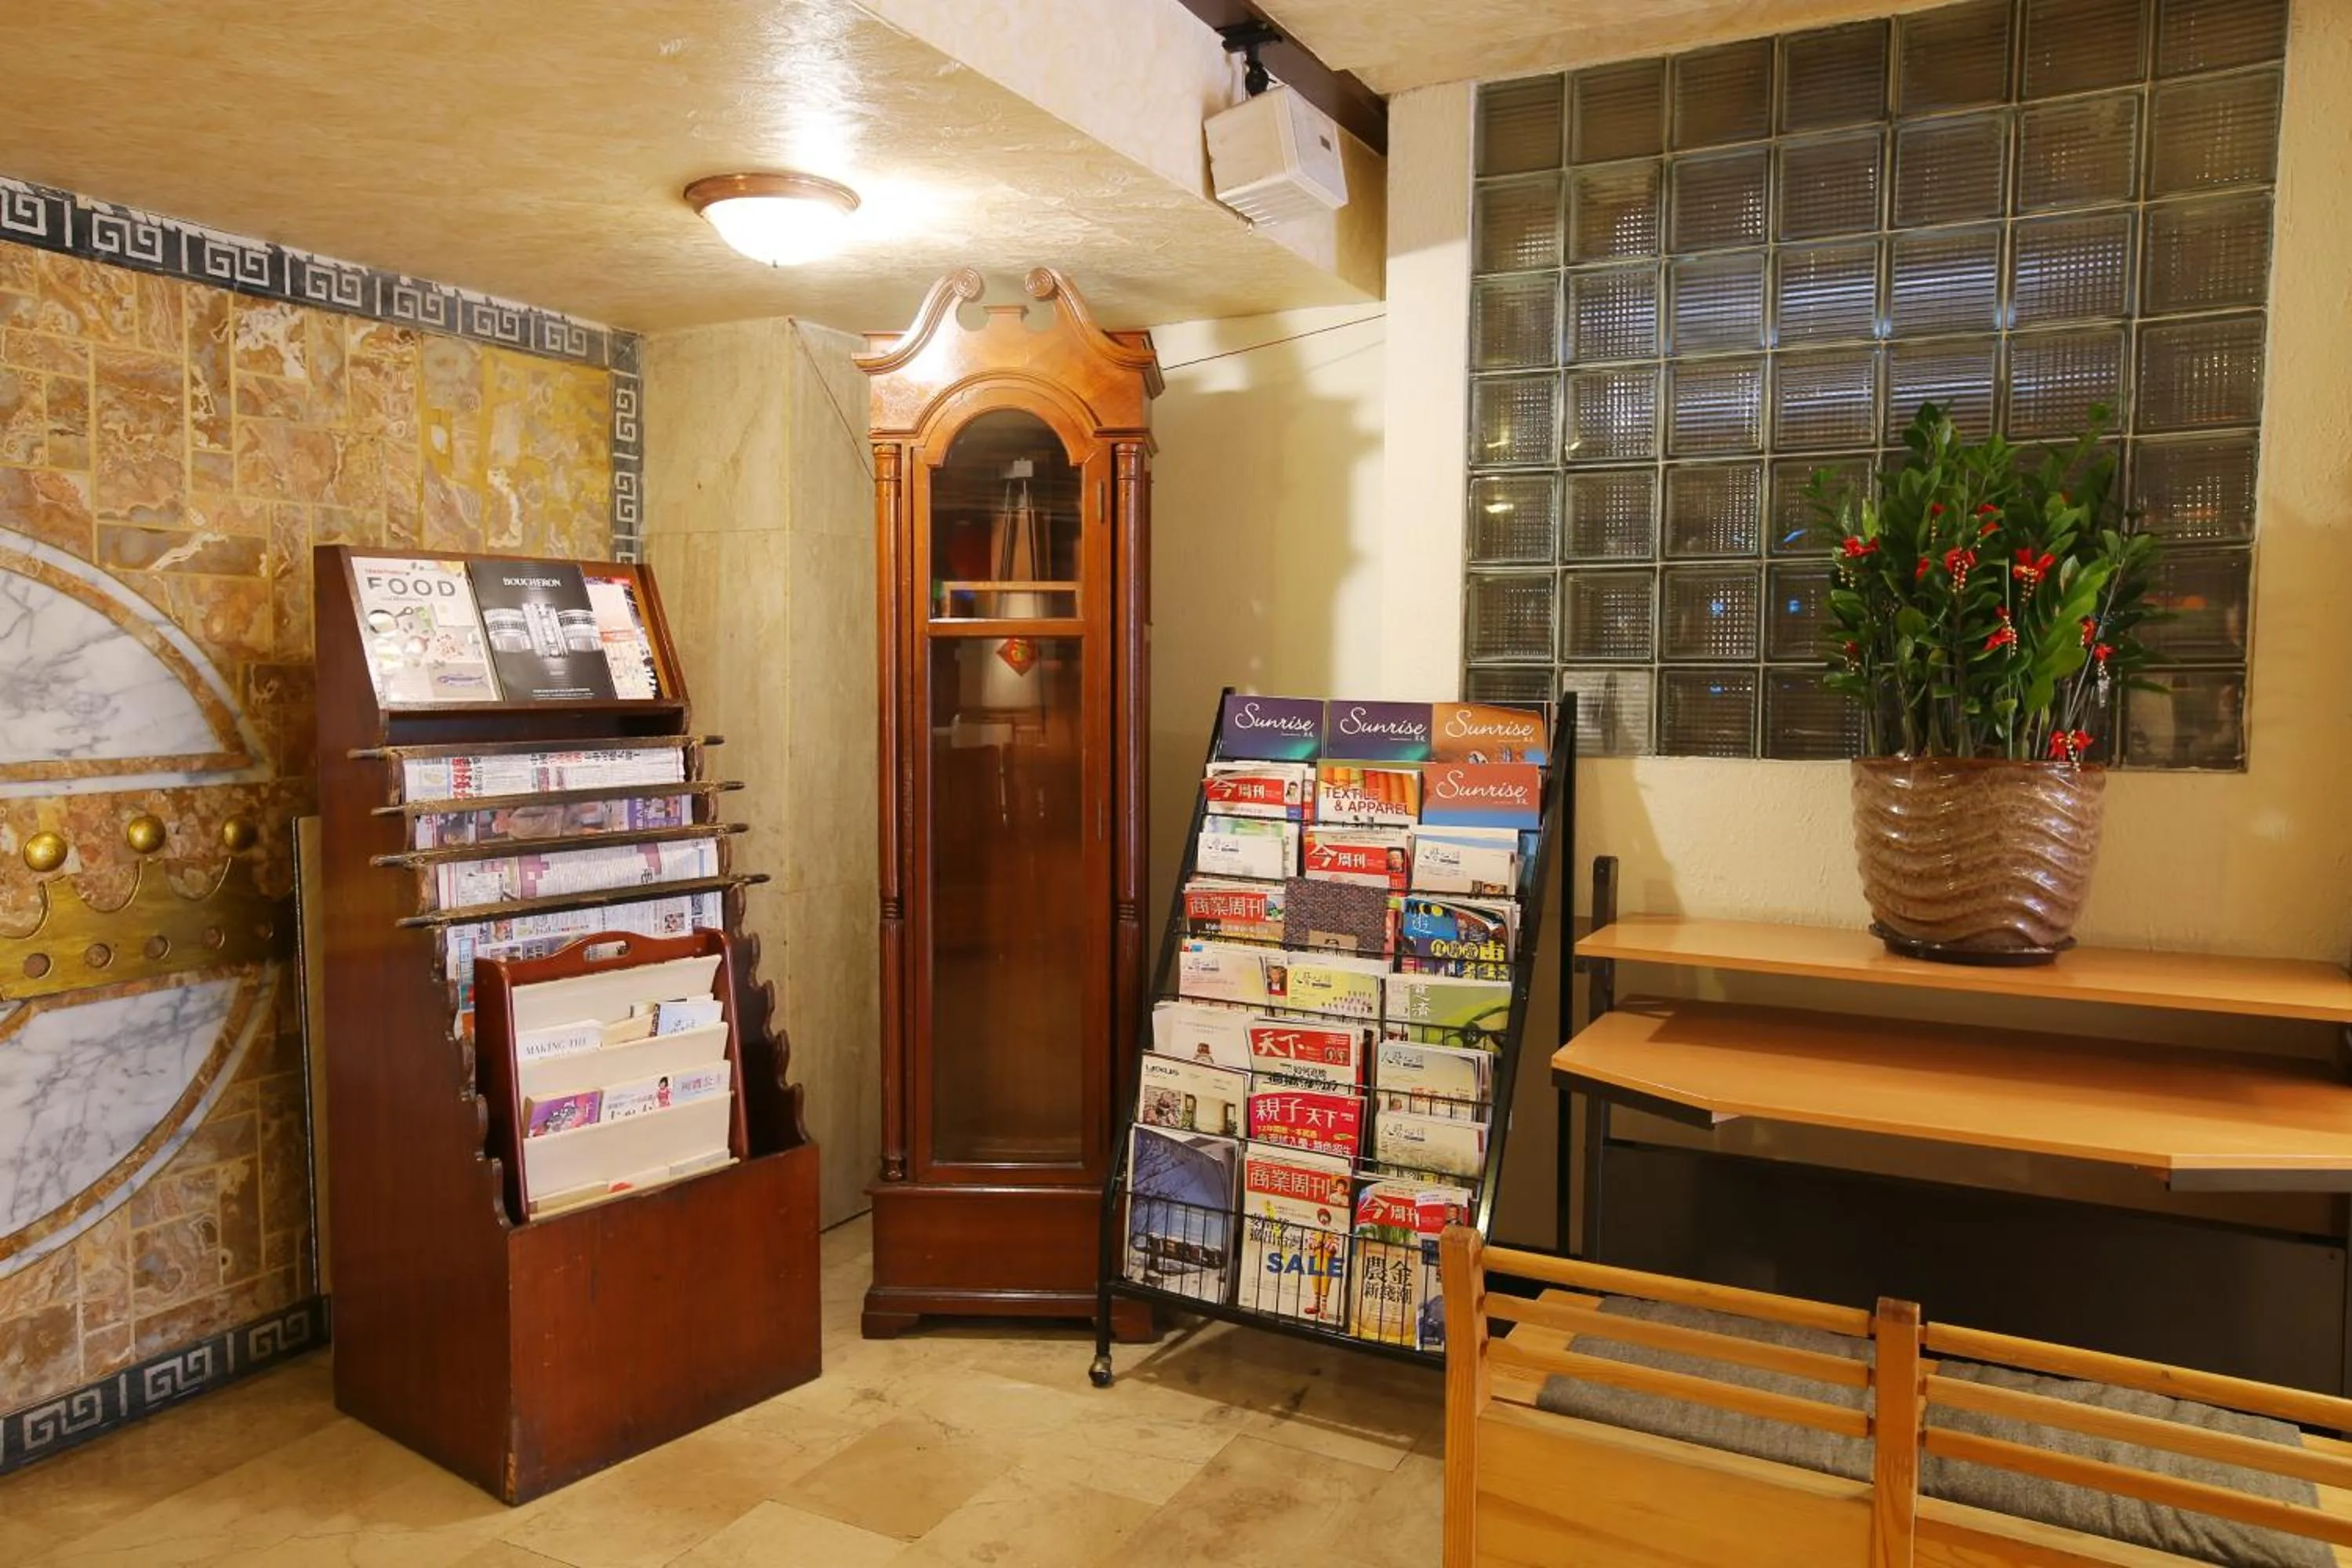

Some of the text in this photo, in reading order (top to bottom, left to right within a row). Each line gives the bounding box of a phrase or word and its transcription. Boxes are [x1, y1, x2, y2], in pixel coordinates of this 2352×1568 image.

[366, 576, 456, 596] FOOD
[503, 576, 562, 587] BOUCHERON
[1235, 702, 1315, 731] Sunrise
[1340, 706, 1427, 735] Sunrise
[1445, 710, 1535, 738] Sunrise
[1208, 779, 1265, 800] 今周刊
[1324, 786, 1381, 800] TEXTILE
[1436, 769, 1528, 798] Sunrise
[1334, 800, 1414, 817] & APPAREL
[1309, 843, 1366, 869] 今周刊
[1189, 894, 1265, 919] 商業周刊
[1255, 1096, 1338, 1129] 親子天下
[1250, 1163, 1331, 1202] 商業周刊
[1359, 1196, 1420, 1229] 今周刊
[1266, 1252, 1345, 1278] SALE
